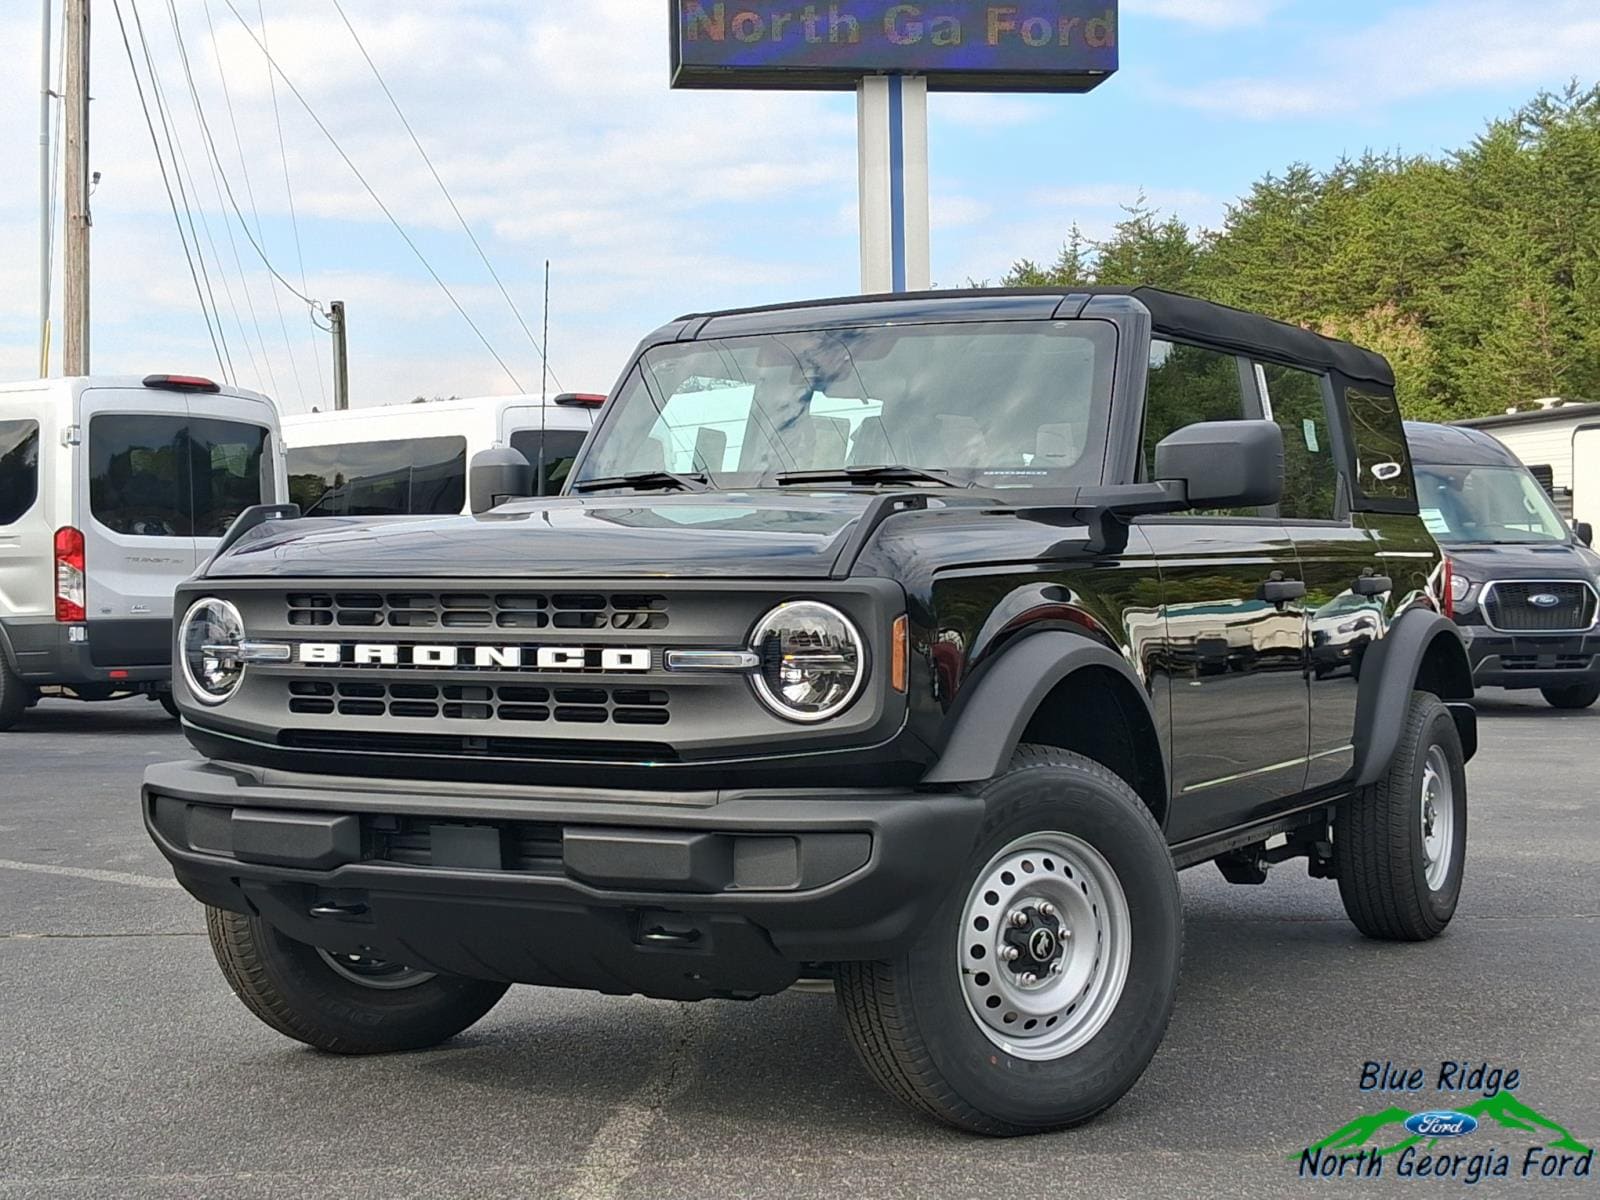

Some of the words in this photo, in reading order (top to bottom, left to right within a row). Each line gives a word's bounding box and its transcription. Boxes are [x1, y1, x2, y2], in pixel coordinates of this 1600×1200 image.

[685, 2, 861, 43] North
[884, 5, 961, 45] Ga
[987, 8, 1115, 47] Ford
[299, 643, 651, 670] BRONCO
